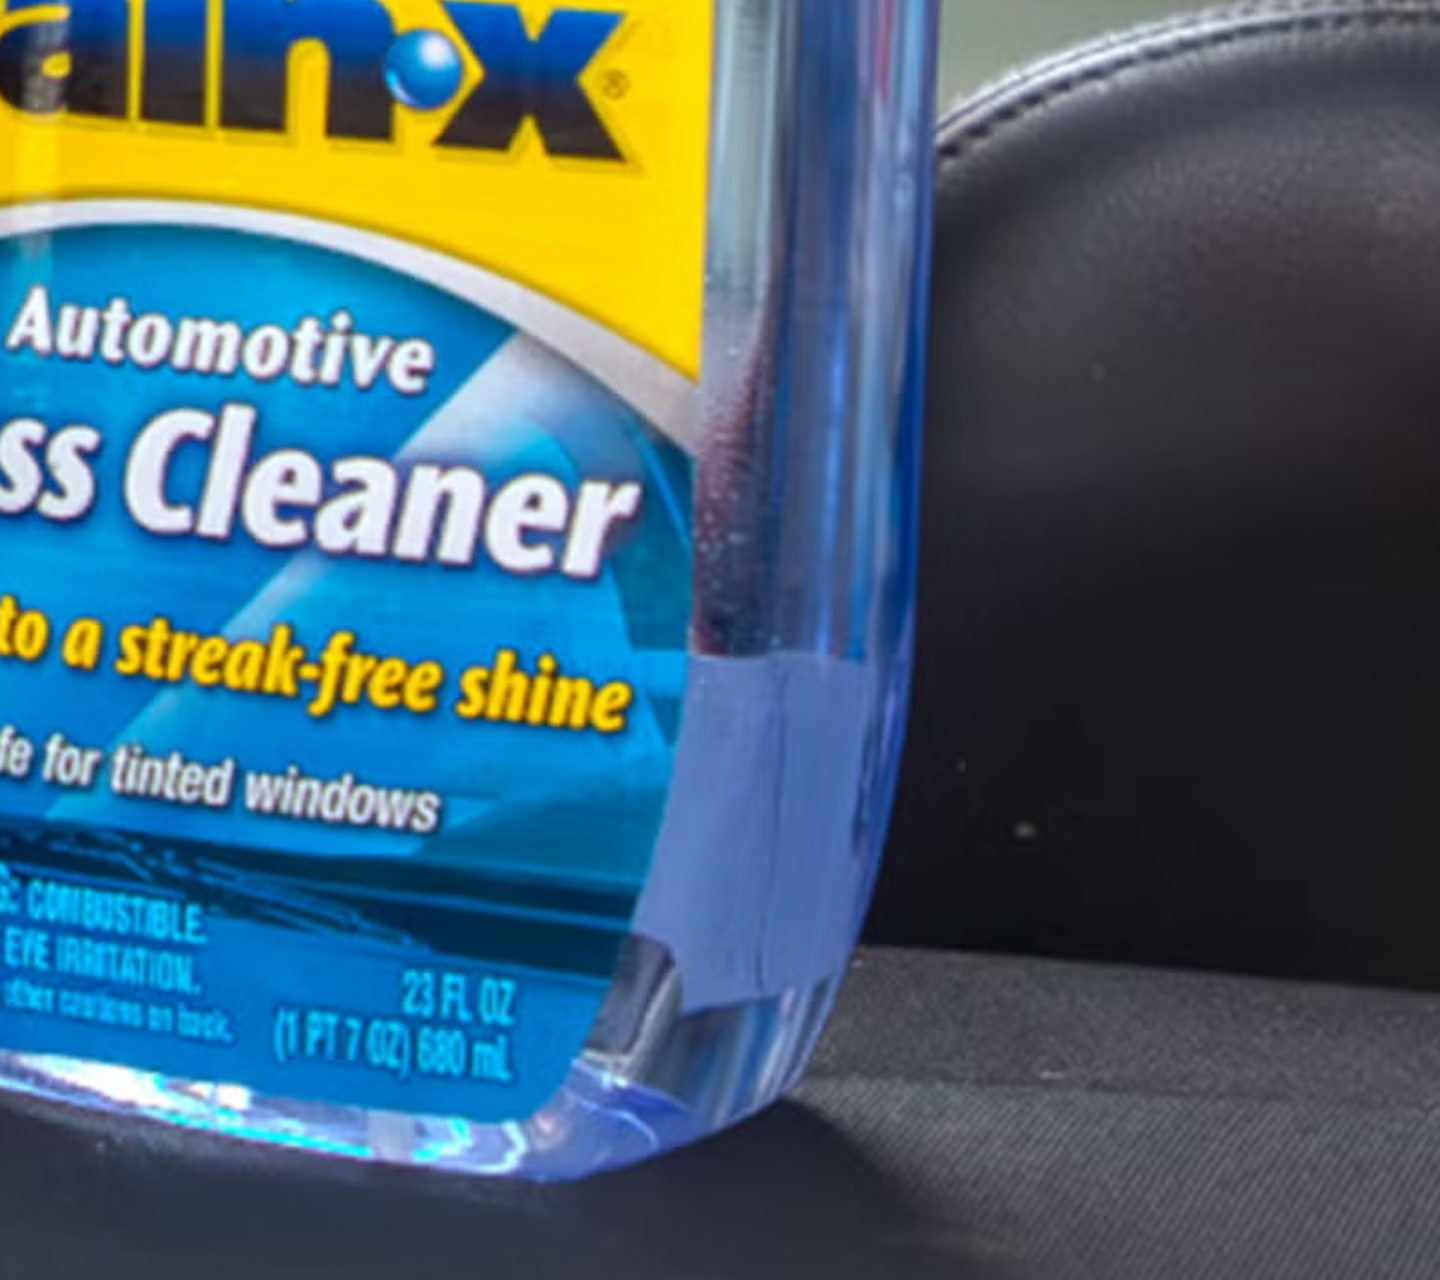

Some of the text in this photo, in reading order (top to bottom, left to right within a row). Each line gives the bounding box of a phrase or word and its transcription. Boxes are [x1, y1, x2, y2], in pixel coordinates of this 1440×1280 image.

[7, 285, 436, 394] Automotive
[121, 402, 643, 580] Cleaner
[62, 620, 103, 670] a
[115, 615, 441, 718] streak-free
[455, 650, 634, 736] shine
[41, 732, 101, 789] for
[109, 742, 232, 809] tinted
[242, 760, 443, 834] windows
[27, 878, 208, 945] COMBUSTIBLE.
[4, 924, 51, 972] EYE
[55, 935, 201, 995] IRRITATION.
[401, 968, 517, 1027] 23 FL OZ
[305, 1009, 340, 1061] PT
[344, 1015, 363, 1061] 7
[365, 1017, 411, 1080] OZ)
[416, 1025, 466, 1077] 680
[471, 1033, 512, 1083] mL
